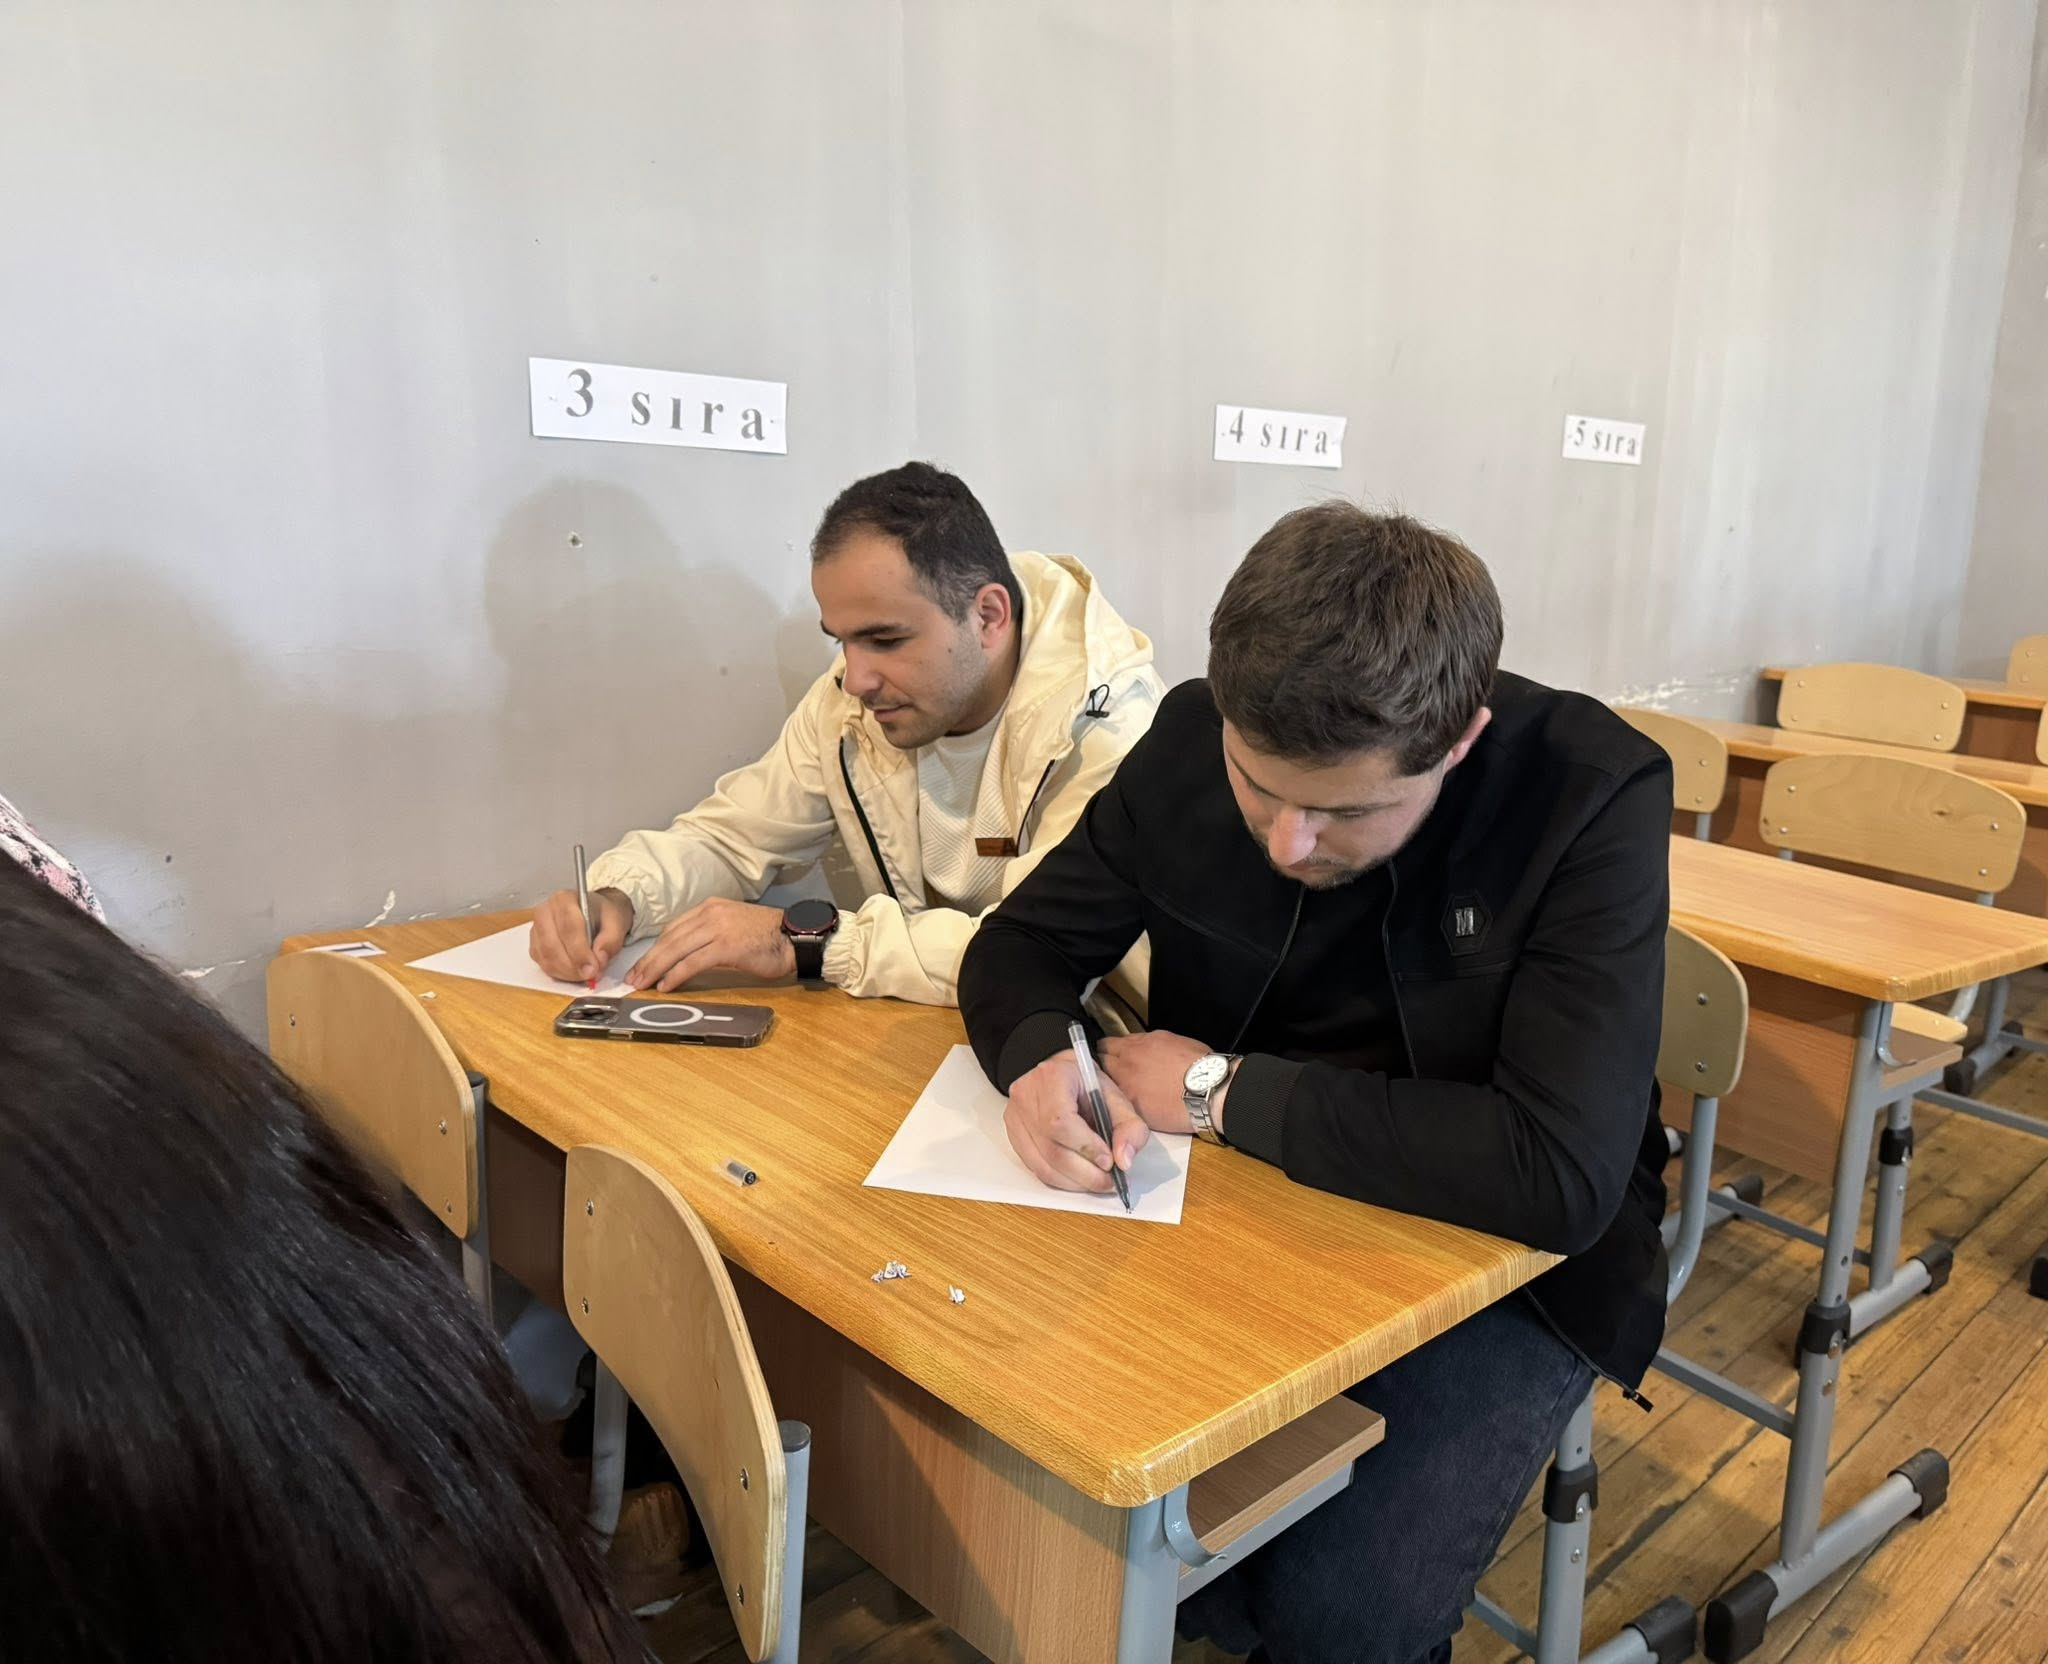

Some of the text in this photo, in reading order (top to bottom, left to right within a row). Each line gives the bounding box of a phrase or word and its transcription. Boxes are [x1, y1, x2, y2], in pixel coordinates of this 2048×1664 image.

[566, 368, 765, 441] 3 sıra
[1229, 409, 1328, 454] 4 sıra
[1573, 420, 1586, 447] 5
